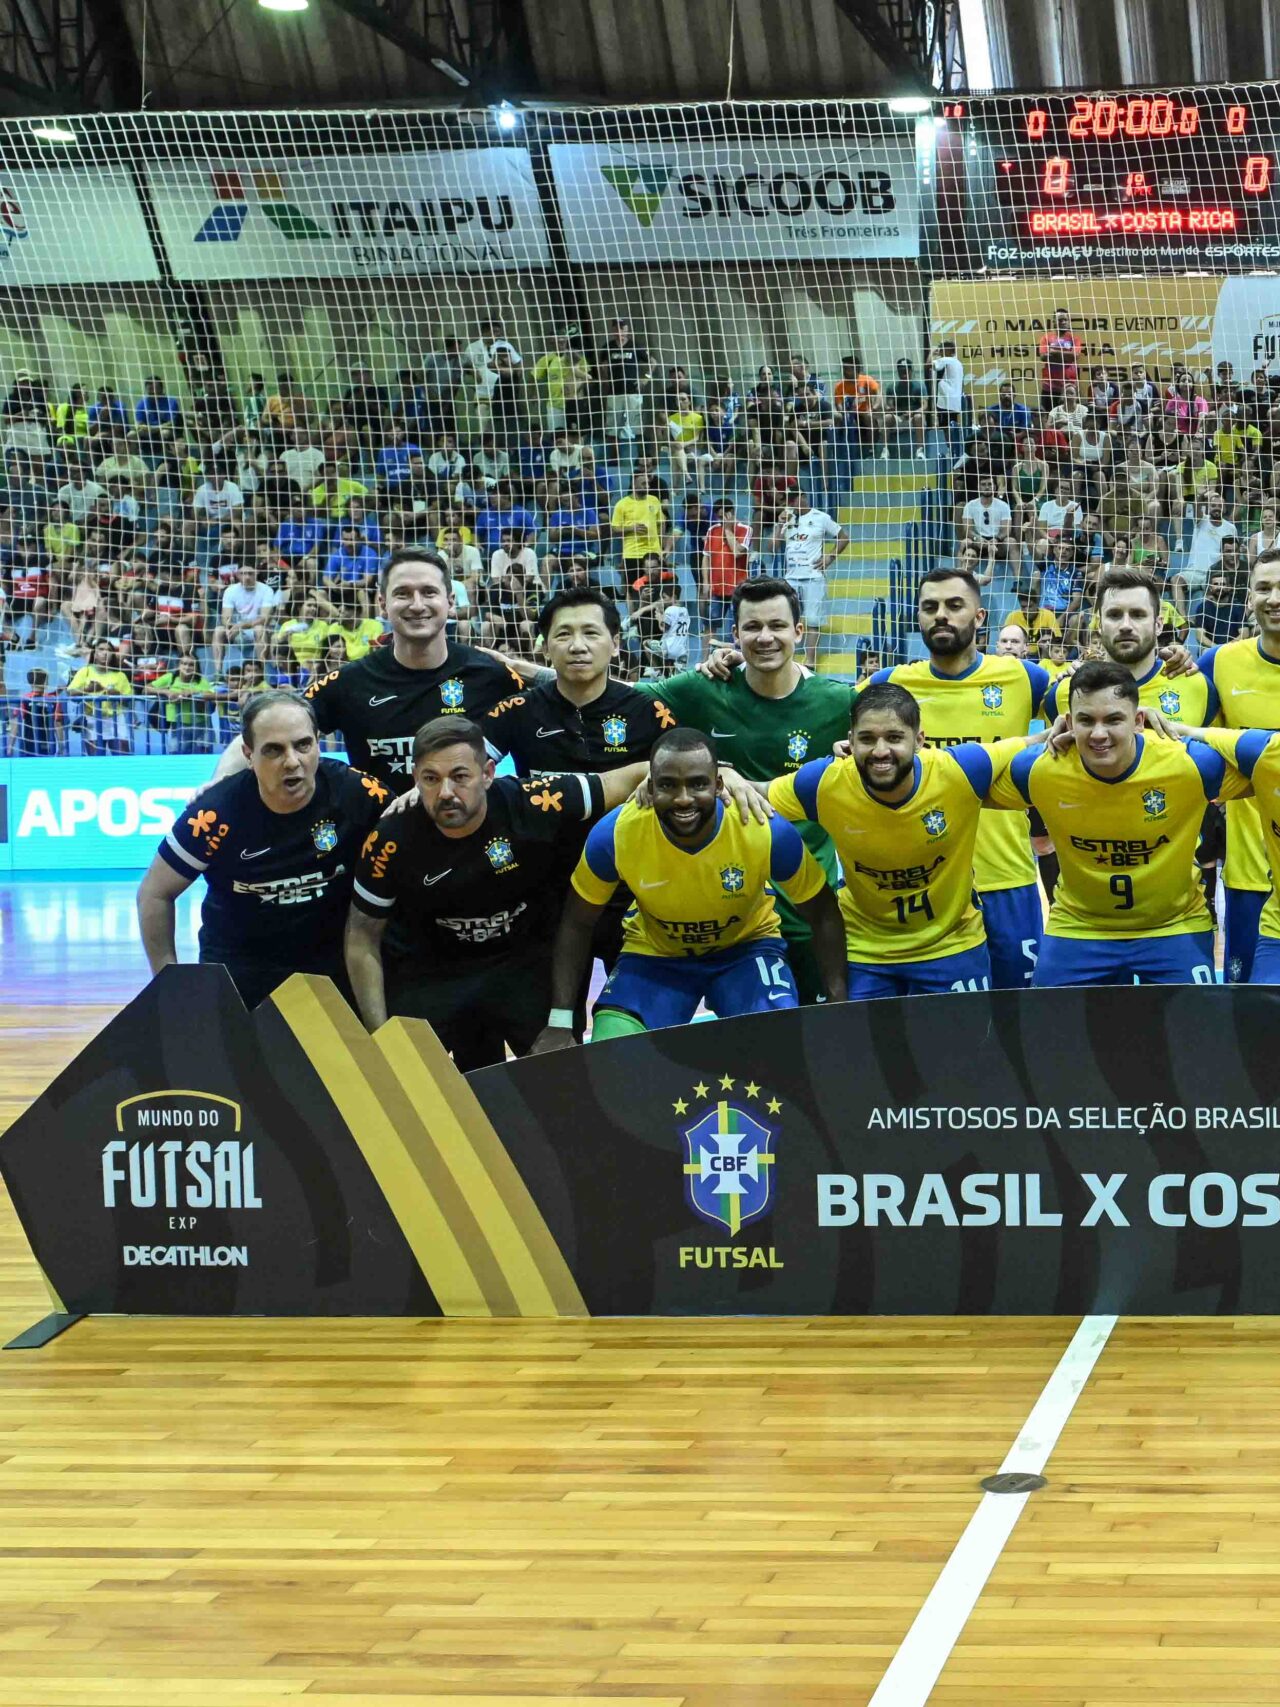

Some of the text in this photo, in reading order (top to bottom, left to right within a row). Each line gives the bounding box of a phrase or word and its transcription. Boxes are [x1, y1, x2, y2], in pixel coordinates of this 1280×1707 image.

[1028, 111, 1046, 136] 0
[1227, 107, 1245, 132] 0
[1044, 158, 1068, 193] 0
[1244, 157, 1269, 191] 0
[677, 170, 897, 218] SICOOB
[331, 193, 515, 239] ITAIPU
[1033, 213, 1101, 231] BRASIL
[1121, 211, 1182, 230] COSTA
[1189, 210, 1235, 229] RICA
[821, 224, 901, 238] Fronteiras
[353, 240, 515, 267] BINACIONAL
[1096, 246, 1139, 257] Destino
[1142, 246, 1157, 257] do
[1160, 246, 1200, 257] Mundo
[1204, 245, 1280, 257] ESPORTES
[1114, 316, 1178, 331] EVENTO
[962, 345, 984, 358] DA
[304, 669, 340, 699] vivo
[488, 696, 526, 719] vivo
[1070, 834, 1171, 854] ESTRELA
[371, 841, 397, 879] vivo
[1110, 852, 1152, 866] BET
[1109, 874, 1135, 910] 9
[890, 890, 935, 924] 14
[137, 1108, 219, 1127] MUNDO DO
[866, 1105, 1018, 1130] AMISTOSOS
[1025, 1106, 1062, 1129] DA
[1068, 1102, 1187, 1135] SELEÇÃO
[101, 1139, 263, 1209] FUTSAL
[710, 1154, 748, 1172] CBF
[816, 1173, 1064, 1228] BRASIL
[1079, 1173, 1131, 1227] X
[168, 1216, 198, 1230] EXP
[123, 1244, 249, 1267] DECATHLON
[678, 1246, 785, 1269] FUTSAL
